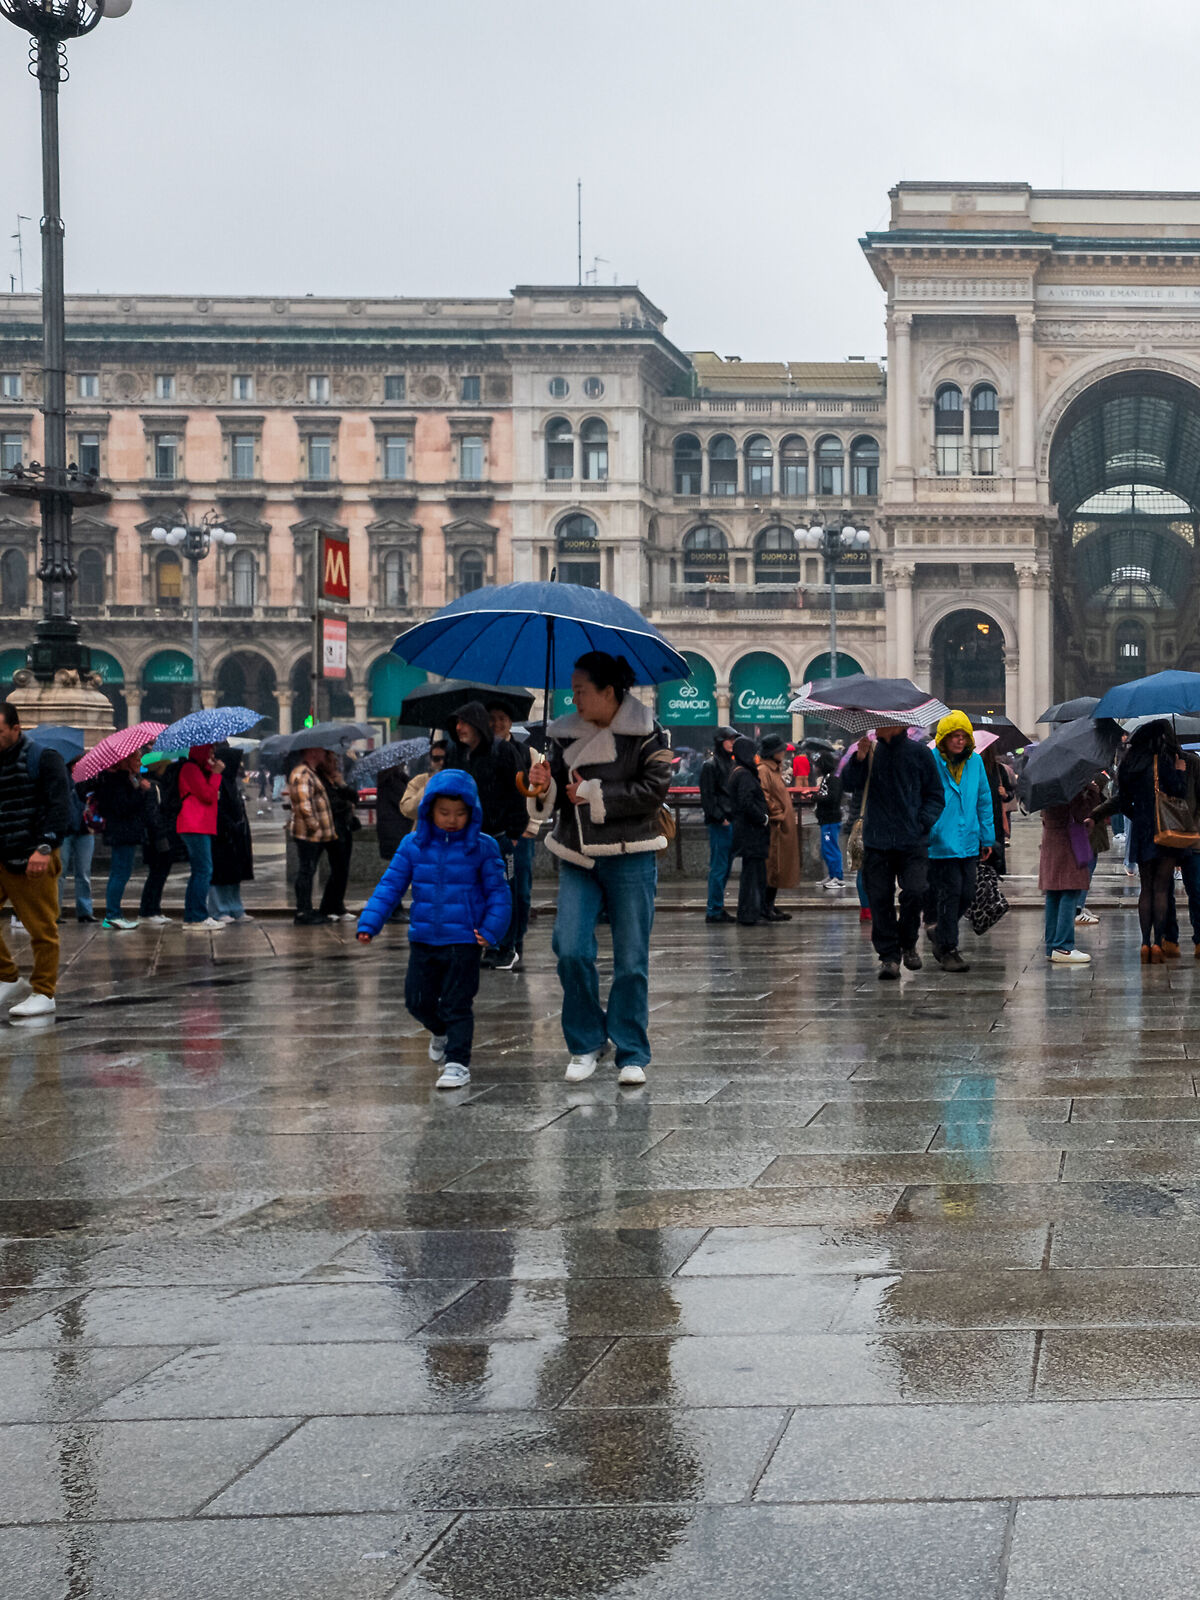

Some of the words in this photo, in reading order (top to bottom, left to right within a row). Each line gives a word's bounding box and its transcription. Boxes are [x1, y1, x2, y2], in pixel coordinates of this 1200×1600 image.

[1060, 289, 1105, 297] VITTORIO
[1110, 289, 1162, 298] EMANUELE
[859, 552, 867, 560] 21
[324, 547, 348, 588] M
[668, 699, 710, 710] GRIMOLDI
[738, 689, 786, 710] Currado
